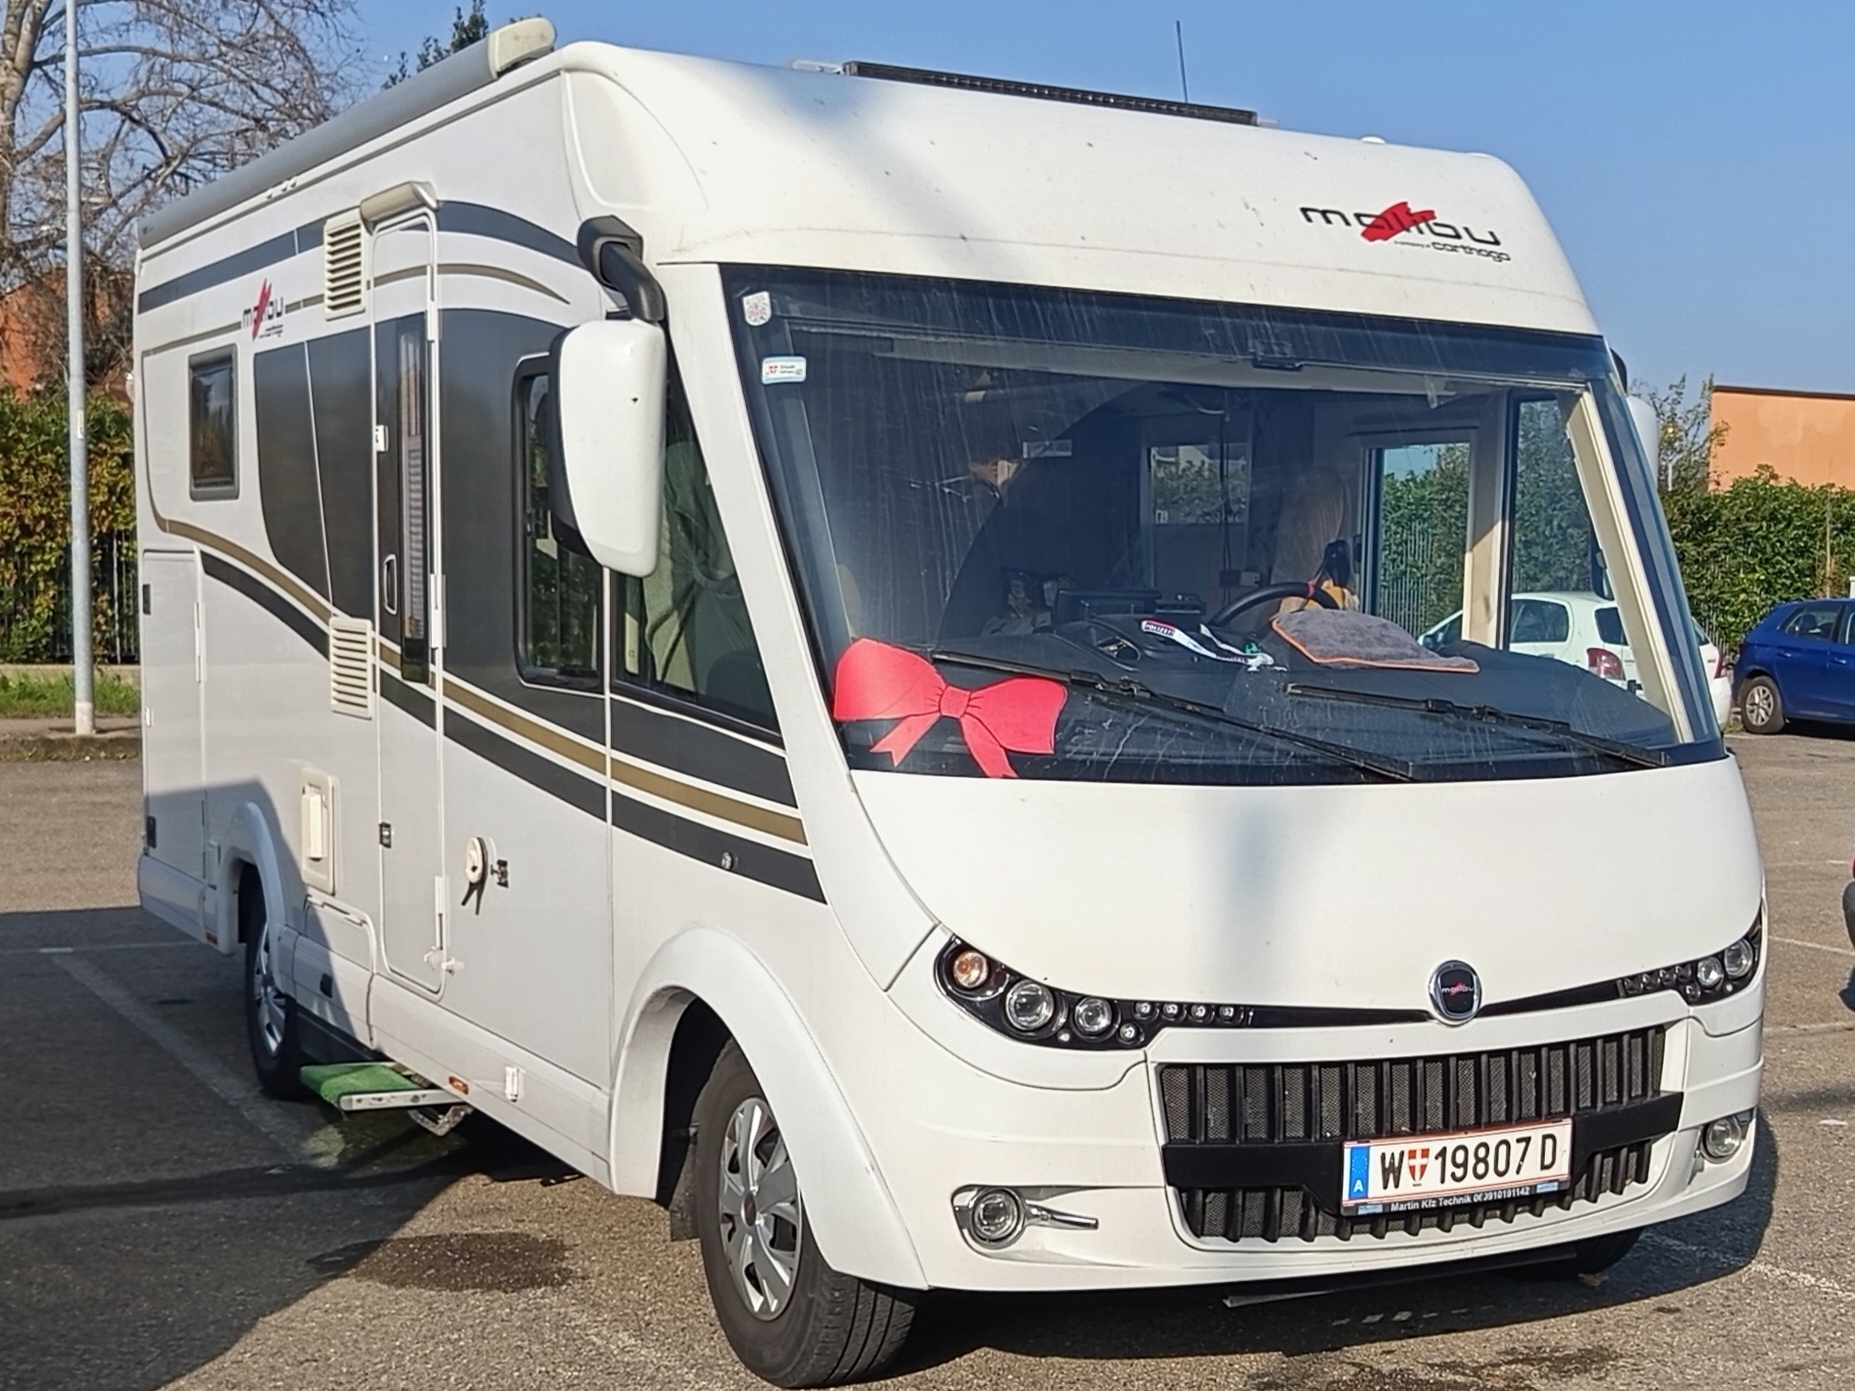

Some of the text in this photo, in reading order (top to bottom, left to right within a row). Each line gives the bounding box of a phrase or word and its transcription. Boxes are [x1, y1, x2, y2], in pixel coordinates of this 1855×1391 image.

[1299, 206, 1501, 247] malibu
[1431, 241, 1512, 262] carthago
[1380, 1133, 1557, 1190] W 19807 D
[1353, 1181, 1364, 1192] A
[1390, 1201, 1419, 1212] Martin
[1421, 1199, 1437, 1209] Kfz
[1439, 1195, 1471, 1207] Technik
